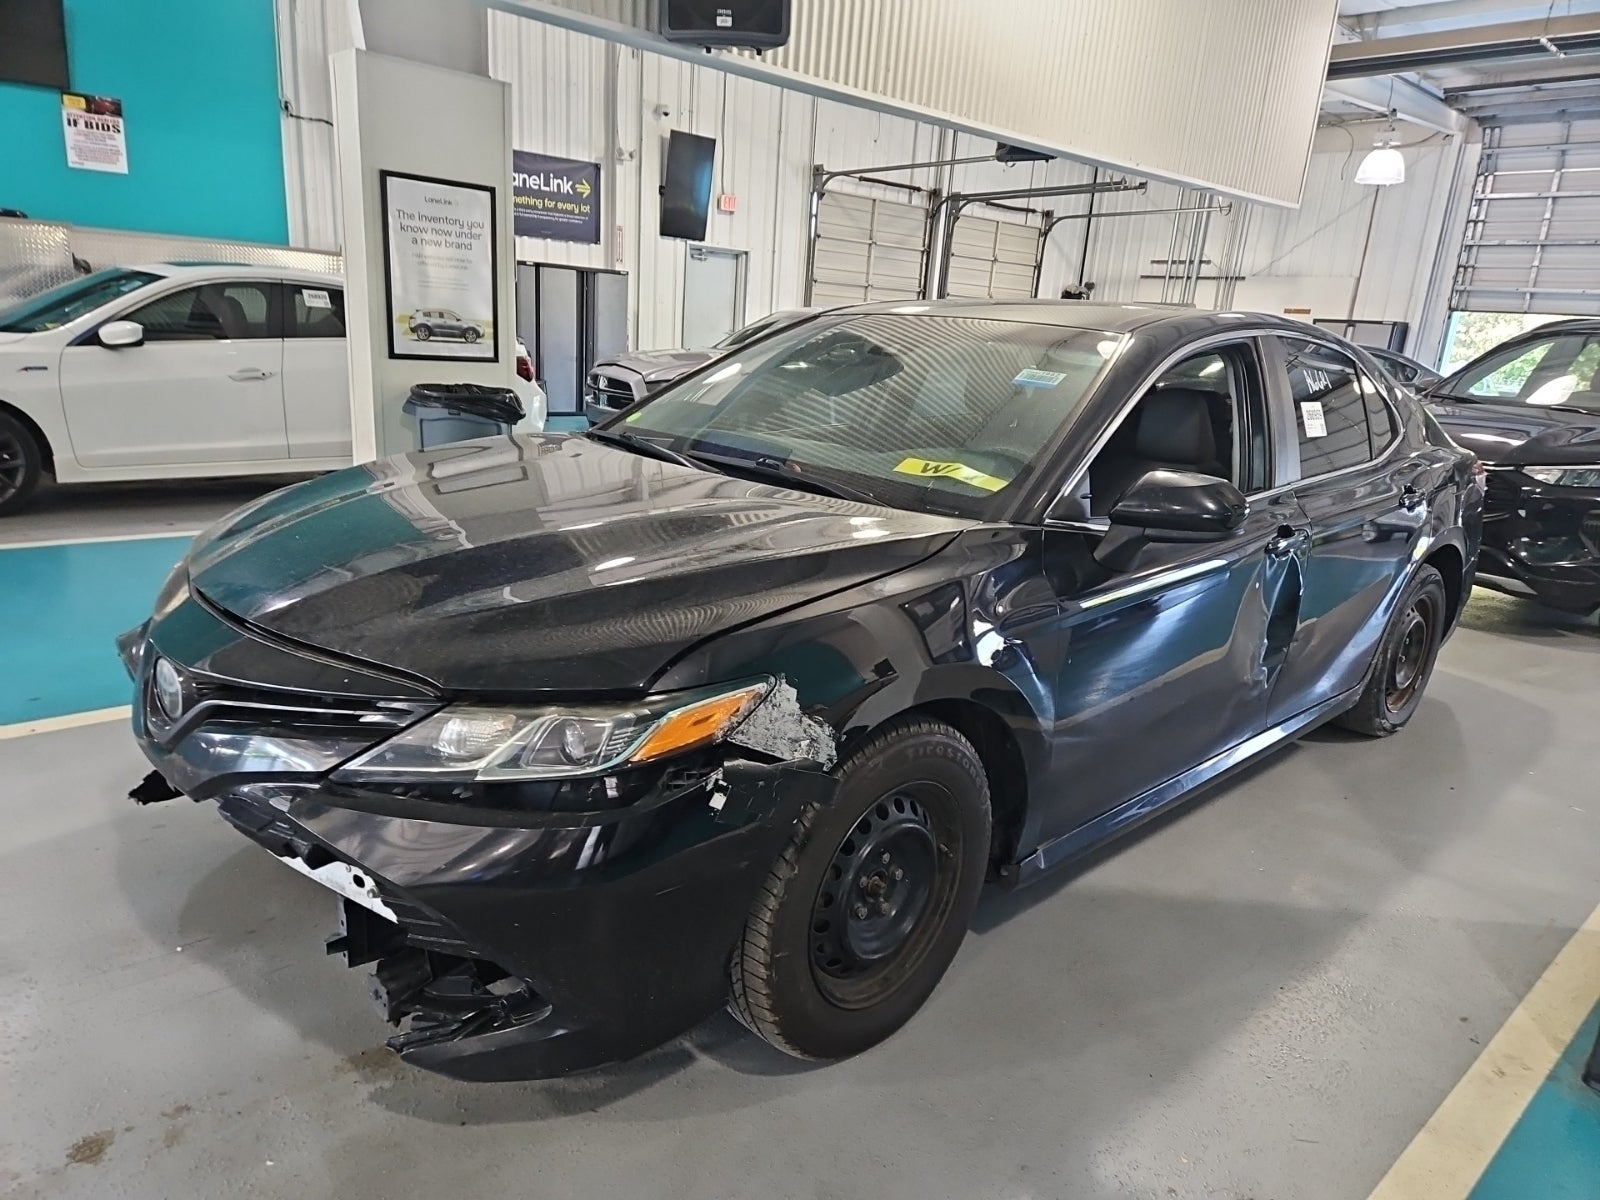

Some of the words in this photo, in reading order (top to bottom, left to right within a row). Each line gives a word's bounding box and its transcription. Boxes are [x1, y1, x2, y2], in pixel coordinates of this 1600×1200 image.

[67, 118, 79, 128] IF
[84, 120, 121, 134] BIDS
[513, 172, 573, 195] aneLink
[545, 198, 556, 208] for
[557, 201, 580, 213] every
[581, 201, 590, 213] lot
[396, 208, 416, 221] The
[466, 220, 485, 231] you
[400, 222, 428, 234] know
[431, 227, 453, 237] now
[455, 230, 483, 240] under
[411, 236, 418, 245] a
[421, 238, 442, 247] new
[444, 239, 473, 251] brand
